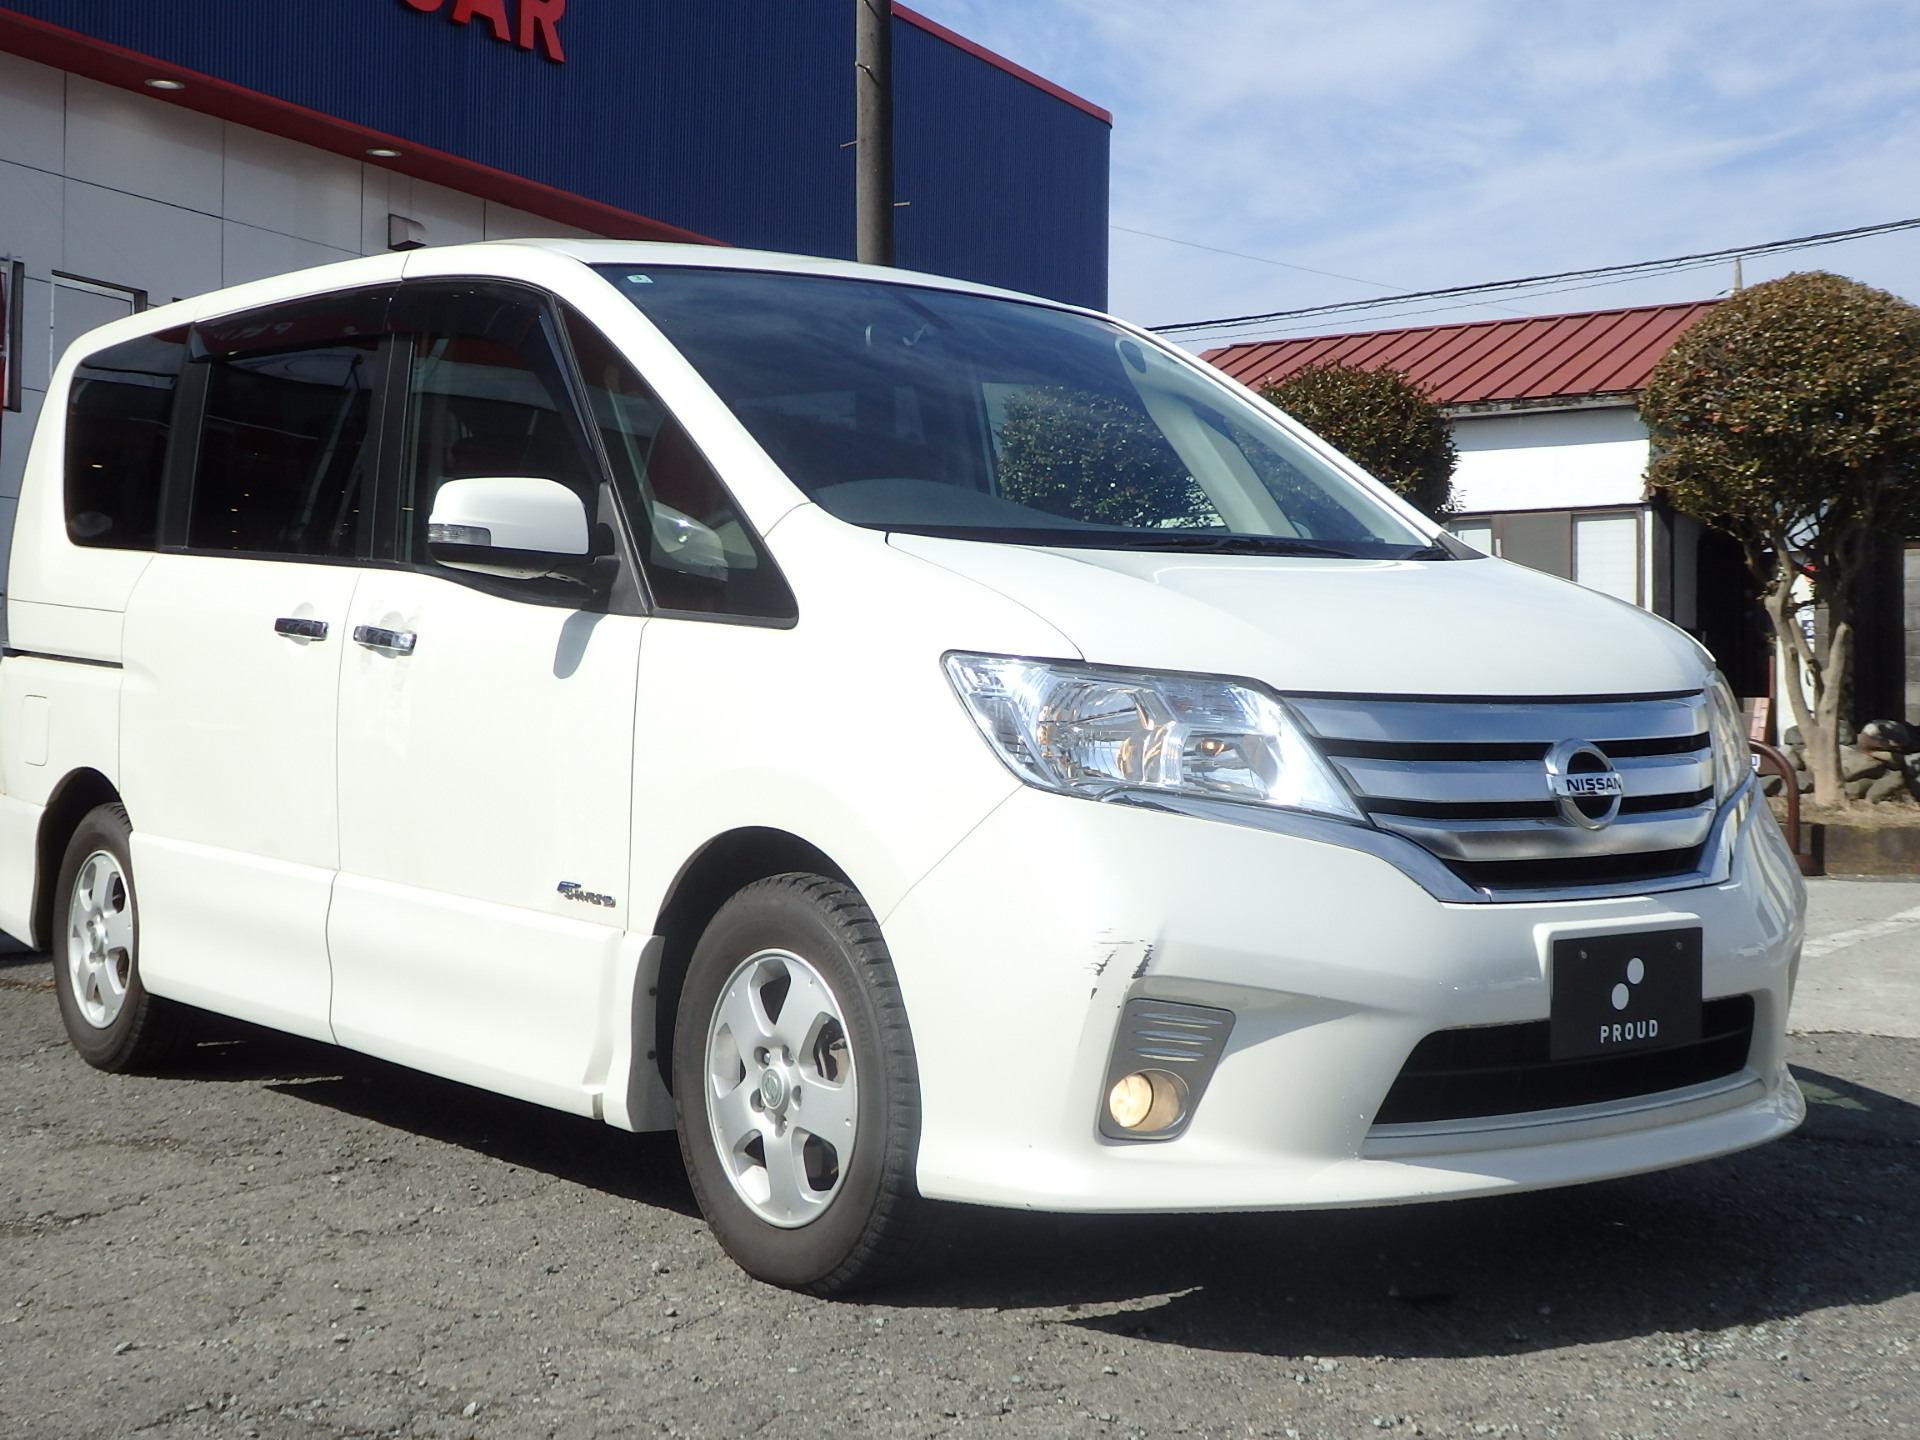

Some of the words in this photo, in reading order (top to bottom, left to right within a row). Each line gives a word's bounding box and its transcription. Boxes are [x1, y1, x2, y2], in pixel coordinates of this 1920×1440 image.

[402, 0, 566, 63] AR
[1566, 777, 1622, 792] NISSAN
[1600, 1019, 1658, 1044] PROUD
